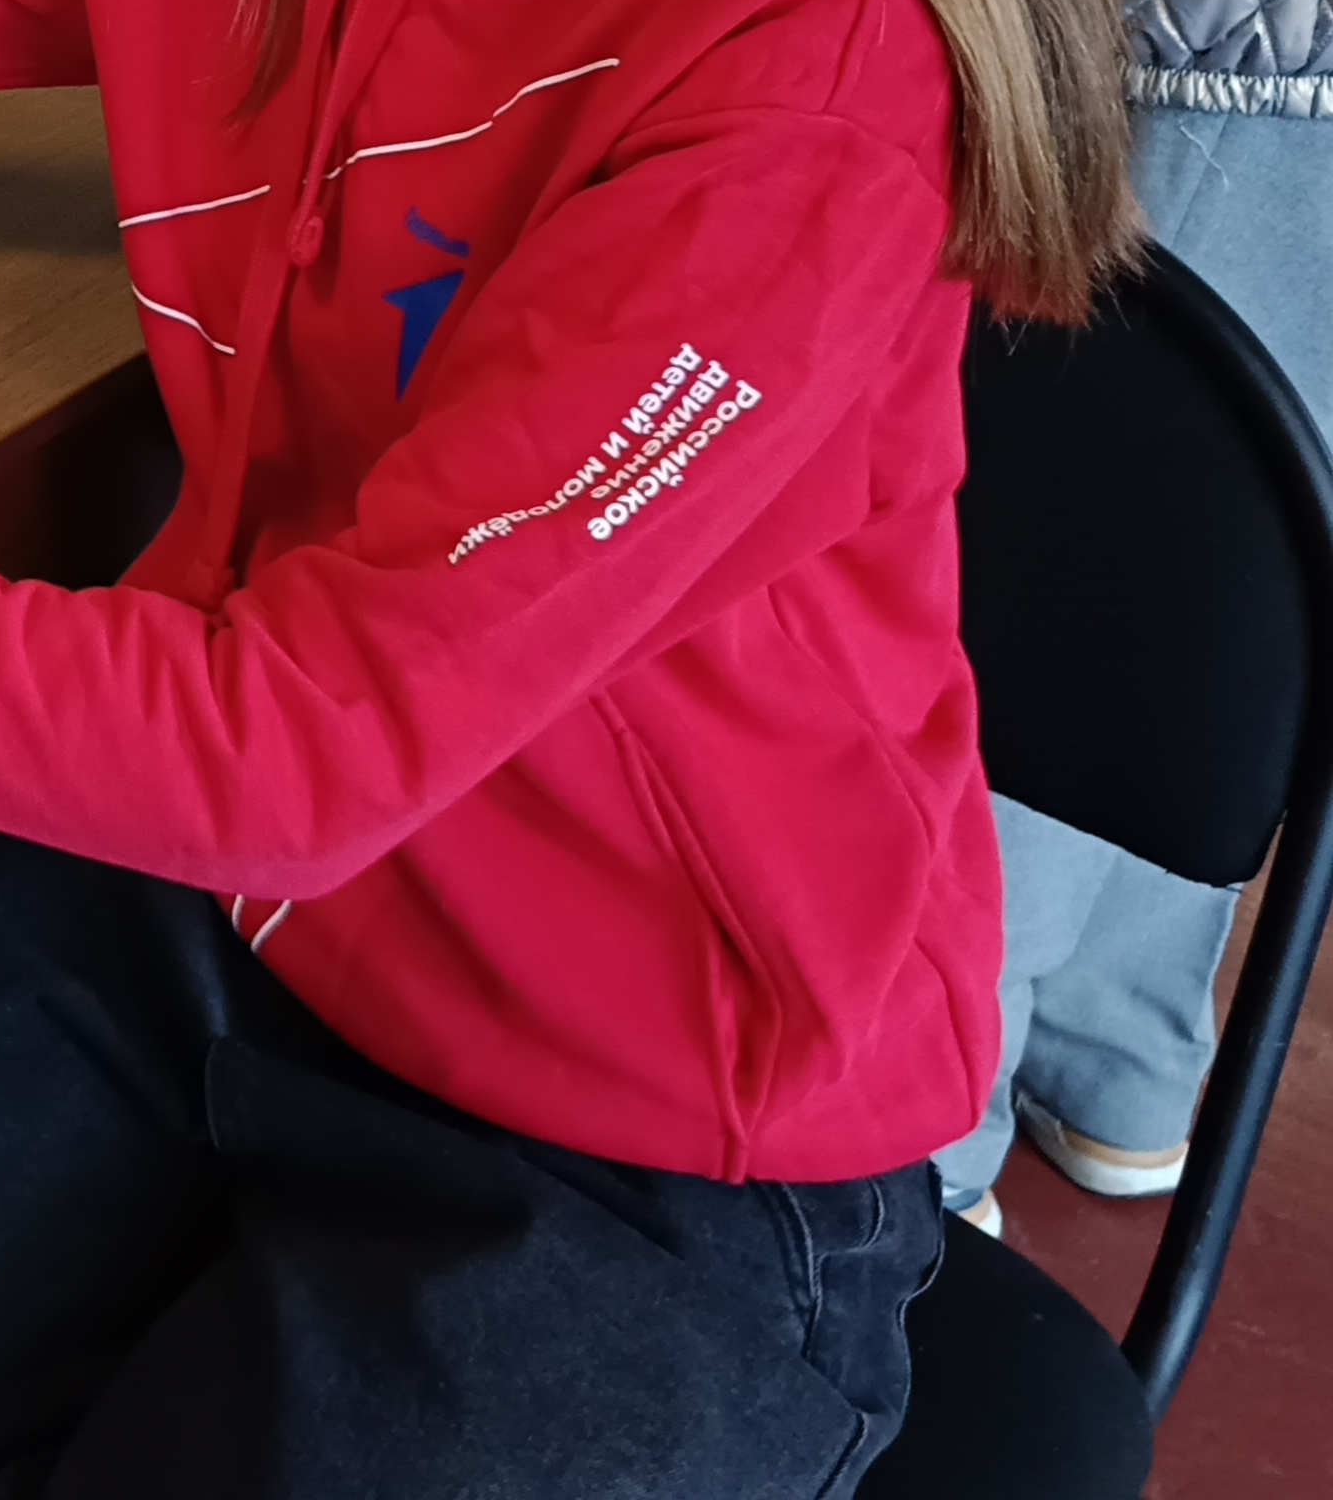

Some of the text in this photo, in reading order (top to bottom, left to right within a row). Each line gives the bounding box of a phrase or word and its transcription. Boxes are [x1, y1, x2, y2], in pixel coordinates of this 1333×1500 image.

[622, 342, 702, 436] детей
[587, 379, 762, 541] Российское
[600, 431, 629, 460] и
